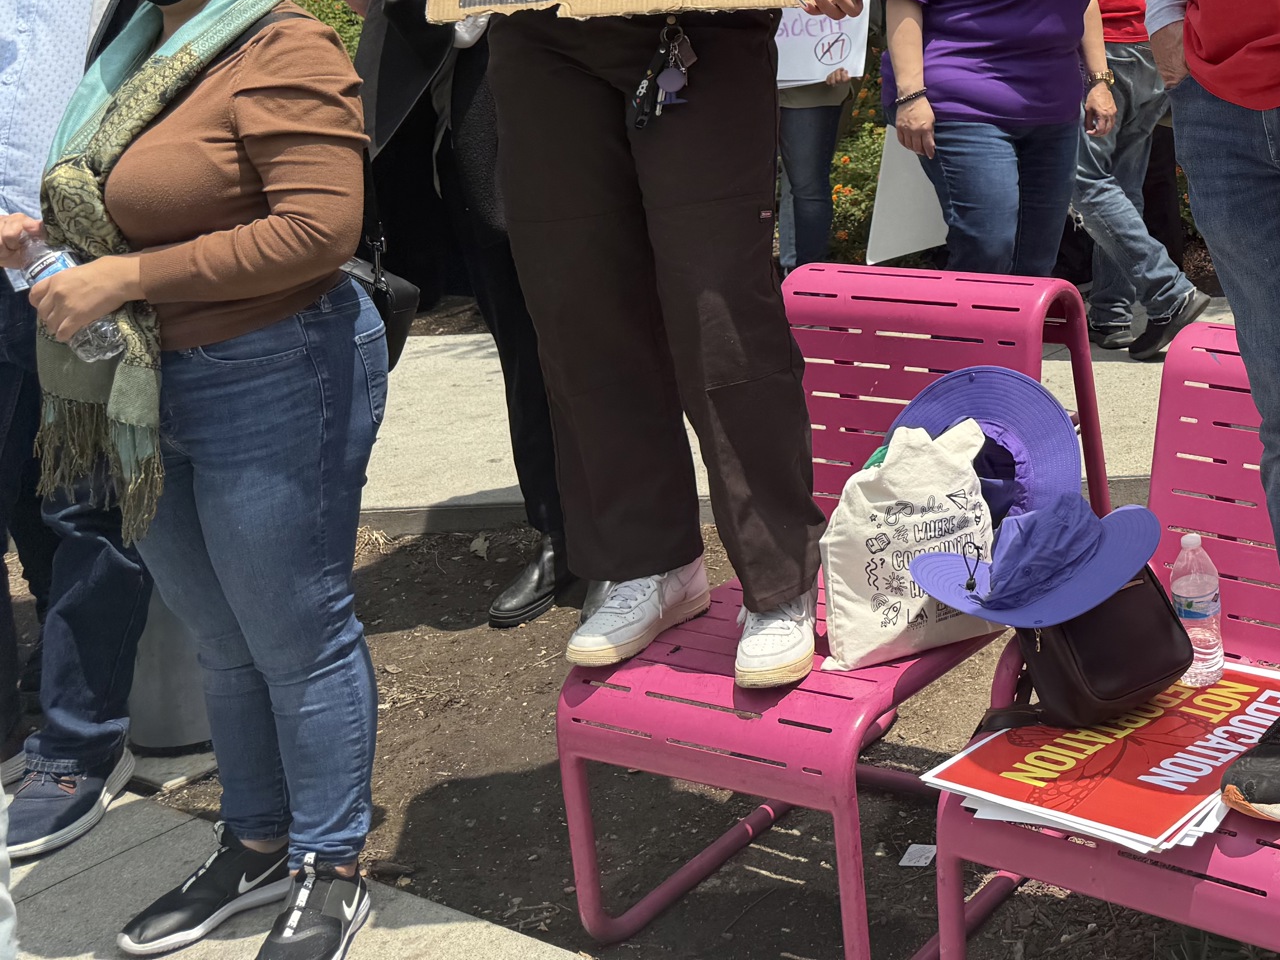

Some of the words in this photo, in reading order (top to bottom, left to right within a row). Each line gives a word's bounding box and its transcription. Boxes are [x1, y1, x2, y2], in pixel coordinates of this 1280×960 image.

[913, 515, 956, 542] WHERE
[1179, 679, 1260, 724] NOT
[1000, 679, 1197, 787] EPORTATION
